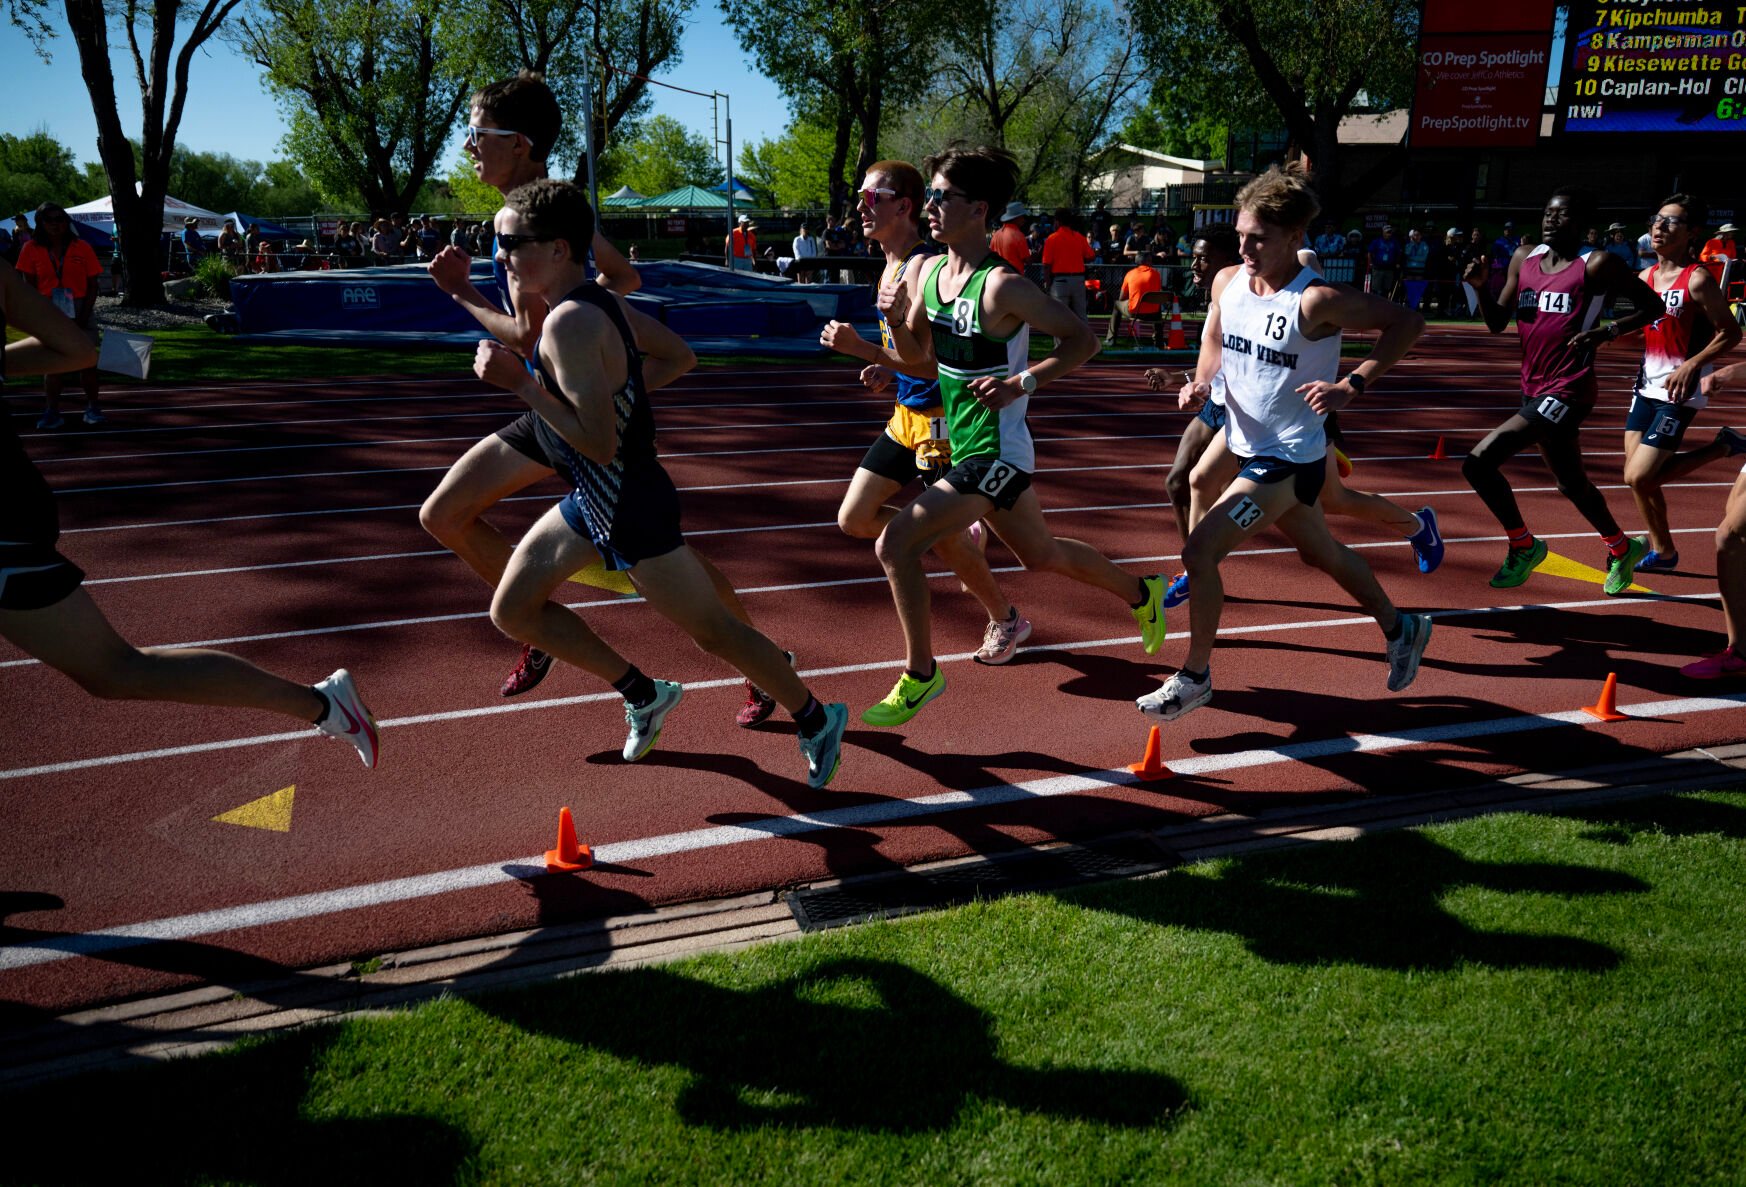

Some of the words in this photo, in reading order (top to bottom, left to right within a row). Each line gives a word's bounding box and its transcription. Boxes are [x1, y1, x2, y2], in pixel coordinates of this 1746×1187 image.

[1595, 10, 1607, 27] 7
[1610, 8, 1722, 30] Kipchumba
[1590, 32, 1604, 50] 8
[1606, 32, 1727, 52] Kamperman
[1731, 29, 1746, 48] O
[1423, 52, 1442, 66] CO
[1445, 52, 1477, 68] Prep
[1479, 50, 1544, 68] Spotlight
[1587, 55, 1601, 72] 9
[1604, 54, 1722, 72] Kiesewette
[1495, 70, 1525, 80] Athletics
[1574, 78, 1597, 96] 10
[1600, 78, 1711, 98] Caplan-Hol
[1723, 77, 1746, 95] Cl
[1567, 101, 1603, 118] nwi
[1421, 115, 1530, 132] PrepSpotlight.tv
[1544, 293, 1564, 311] 14
[1662, 290, 1679, 306] 15
[955, 300, 970, 334] 8
[1264, 312, 1287, 340] 13
[1257, 344, 1299, 370] VIEW
[1542, 399, 1566, 420] 14
[984, 465, 1009, 492] 8
[1234, 501, 1261, 527] 13
